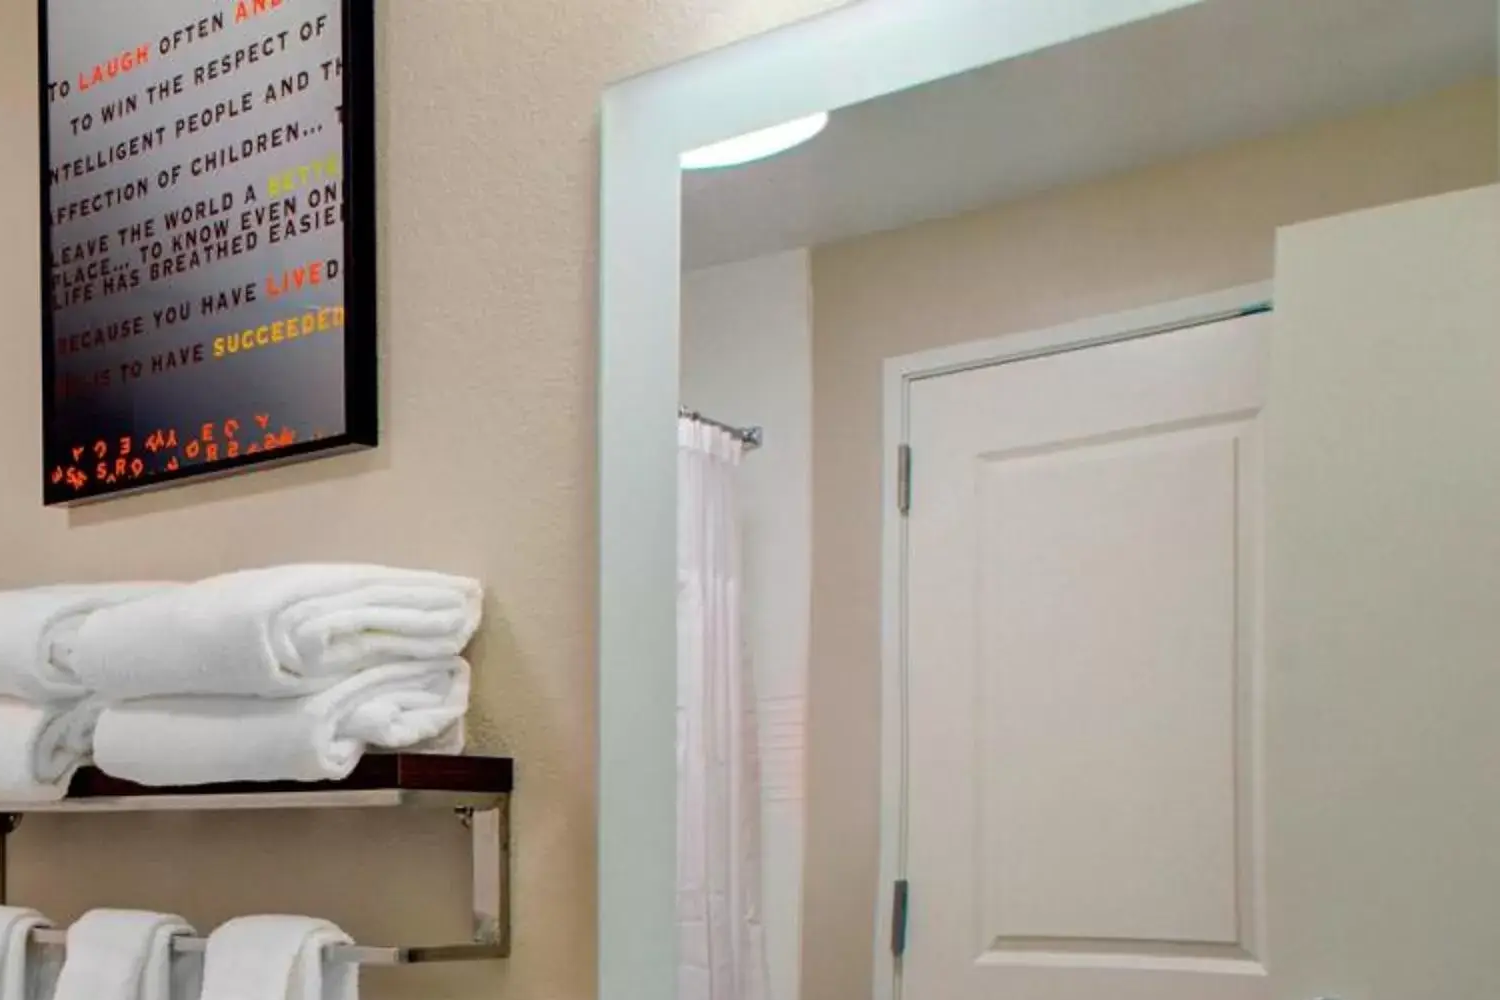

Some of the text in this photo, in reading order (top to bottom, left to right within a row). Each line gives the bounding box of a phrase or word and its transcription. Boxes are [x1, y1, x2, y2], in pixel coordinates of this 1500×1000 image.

[47, 80, 70, 102] TO
[78, 43, 151, 91] LAUGH
[159, 12, 223, 54] OFTEN
[70, 14, 327, 136] TO WIN THE RESPECT OF
[176, 92, 252, 138] PEOPLE
[265, 71, 309, 104] AND
[158, 165, 181, 188] OF
[191, 121, 323, 176] CHILDREN...
[50, 235, 109, 268] LEAVE
[118, 219, 155, 247] THE
[164, 192, 233, 231] WORLD
[244, 184, 256, 204] A
[52, 204, 344, 311] LIFE HAS BREATHED EASIE
[139, 241, 162, 264] TO
[172, 219, 229, 253] KNOW
[241, 196, 296, 231] EVEN
[308, 181, 337, 208] ON
[57, 259, 338, 355] BECAUSE YOU HAVE LIVED
[120, 361, 143, 383] TO
[152, 344, 204, 373] HAVE
[213, 306, 343, 358] SUCCEEDED
